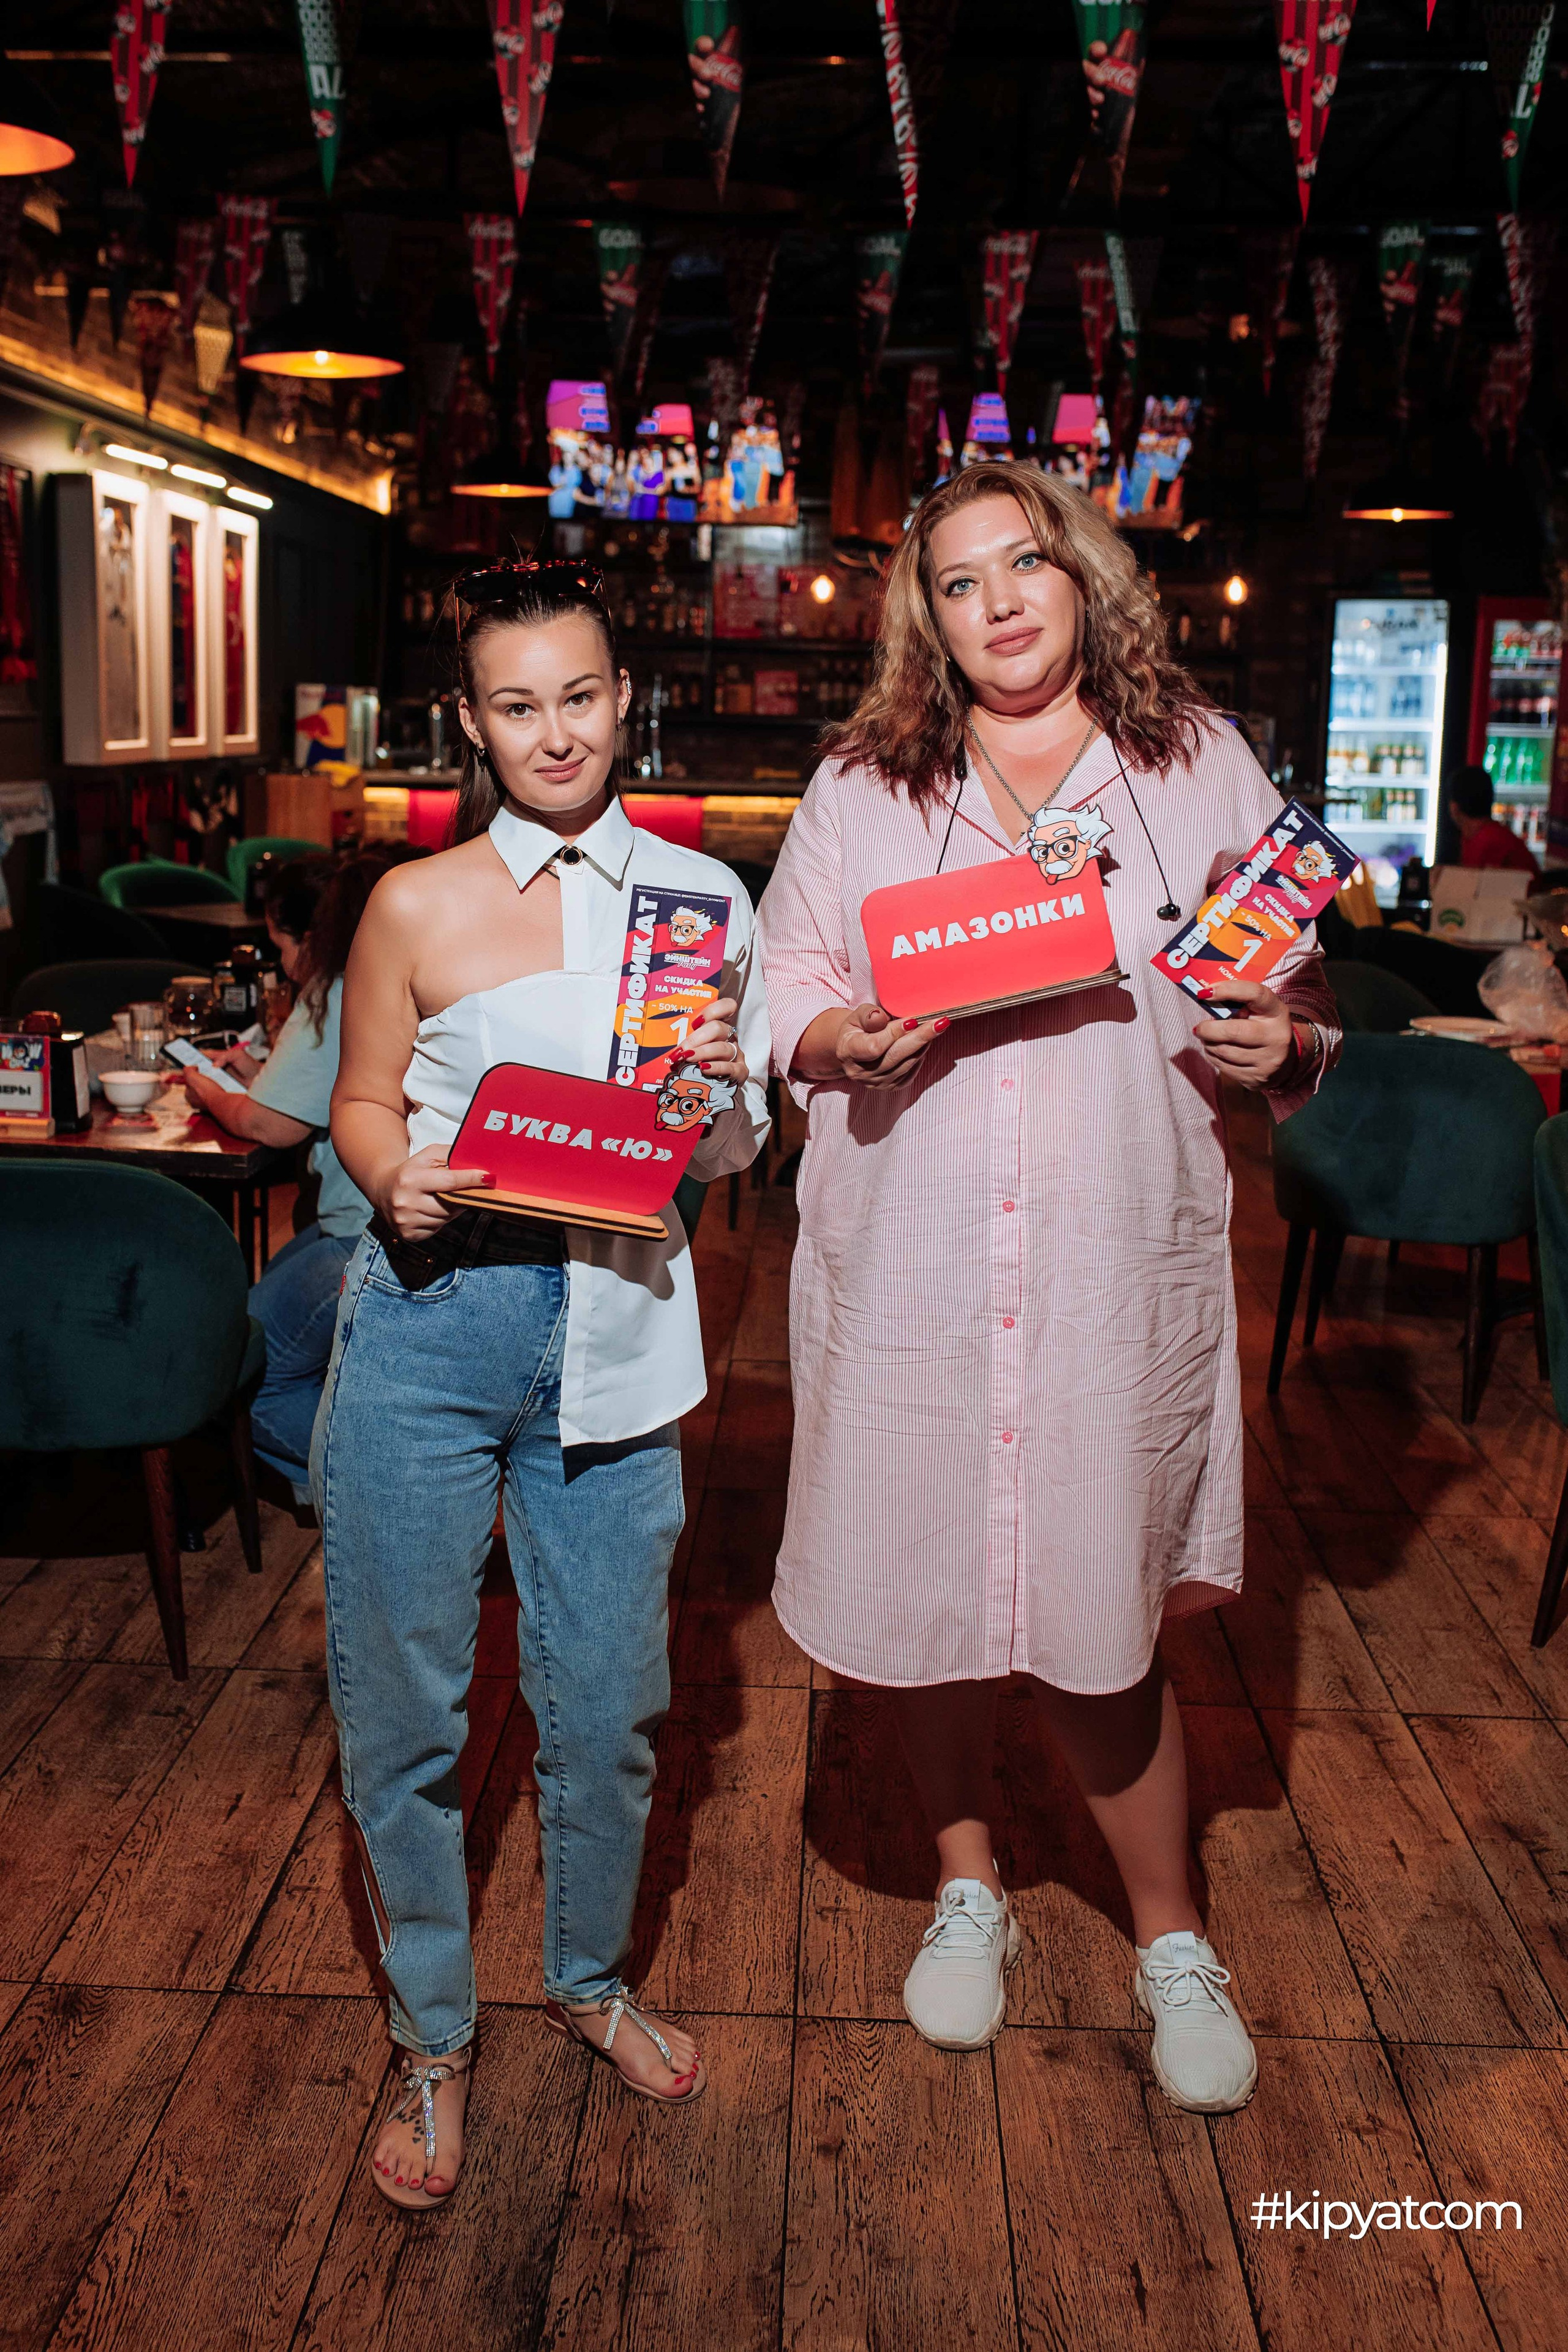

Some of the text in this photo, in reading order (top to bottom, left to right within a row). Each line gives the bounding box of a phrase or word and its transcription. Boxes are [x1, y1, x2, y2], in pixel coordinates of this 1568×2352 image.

[1167, 810, 1303, 969] СЕРТИФИКАТ
[1252, 896, 1295, 937] НА УЧАСТИЕ
[1265, 894, 1294, 923] СКИДКА
[891, 893, 1085, 959] АМАЗОНКИ
[1259, 928, 1272, 941] НА
[664, 953, 711, 966] ЭЙНШТЕЙН
[1233, 939, 1263, 972] 1
[615, 895, 658, 1087] СЕРТИФИКАТ
[655, 984, 712, 998] НА УЧАСТИЕ
[664, 975, 704, 987] СКИДКА
[658, 1003, 678, 1012] 50%
[670, 1017, 689, 1046] 1
[0, 1085, 31, 1095] ЕРЫ
[483, 1110, 673, 1161] БУКВА «Ю»
